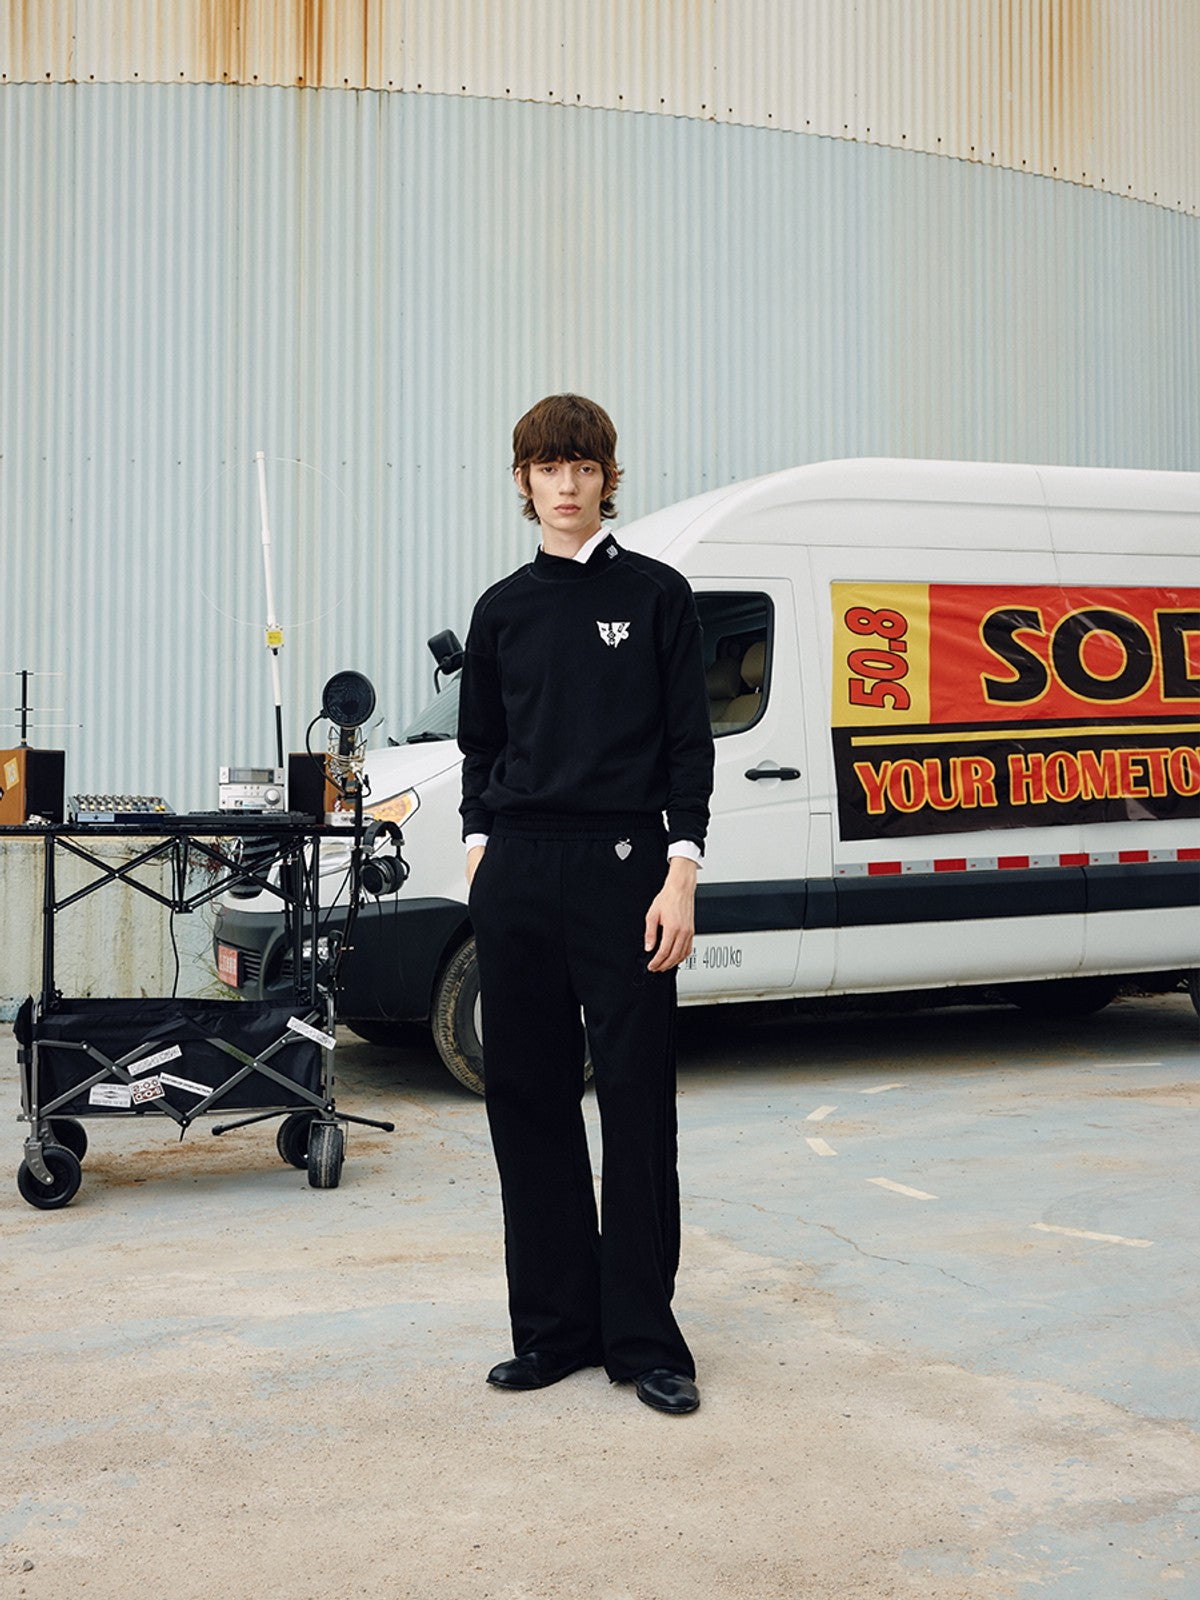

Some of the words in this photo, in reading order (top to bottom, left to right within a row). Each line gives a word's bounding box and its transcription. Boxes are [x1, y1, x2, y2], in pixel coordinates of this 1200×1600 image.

[844, 606, 911, 710] 50.8
[853, 756, 998, 815] YOUR
[1008, 746, 1200, 806] HOMETO
